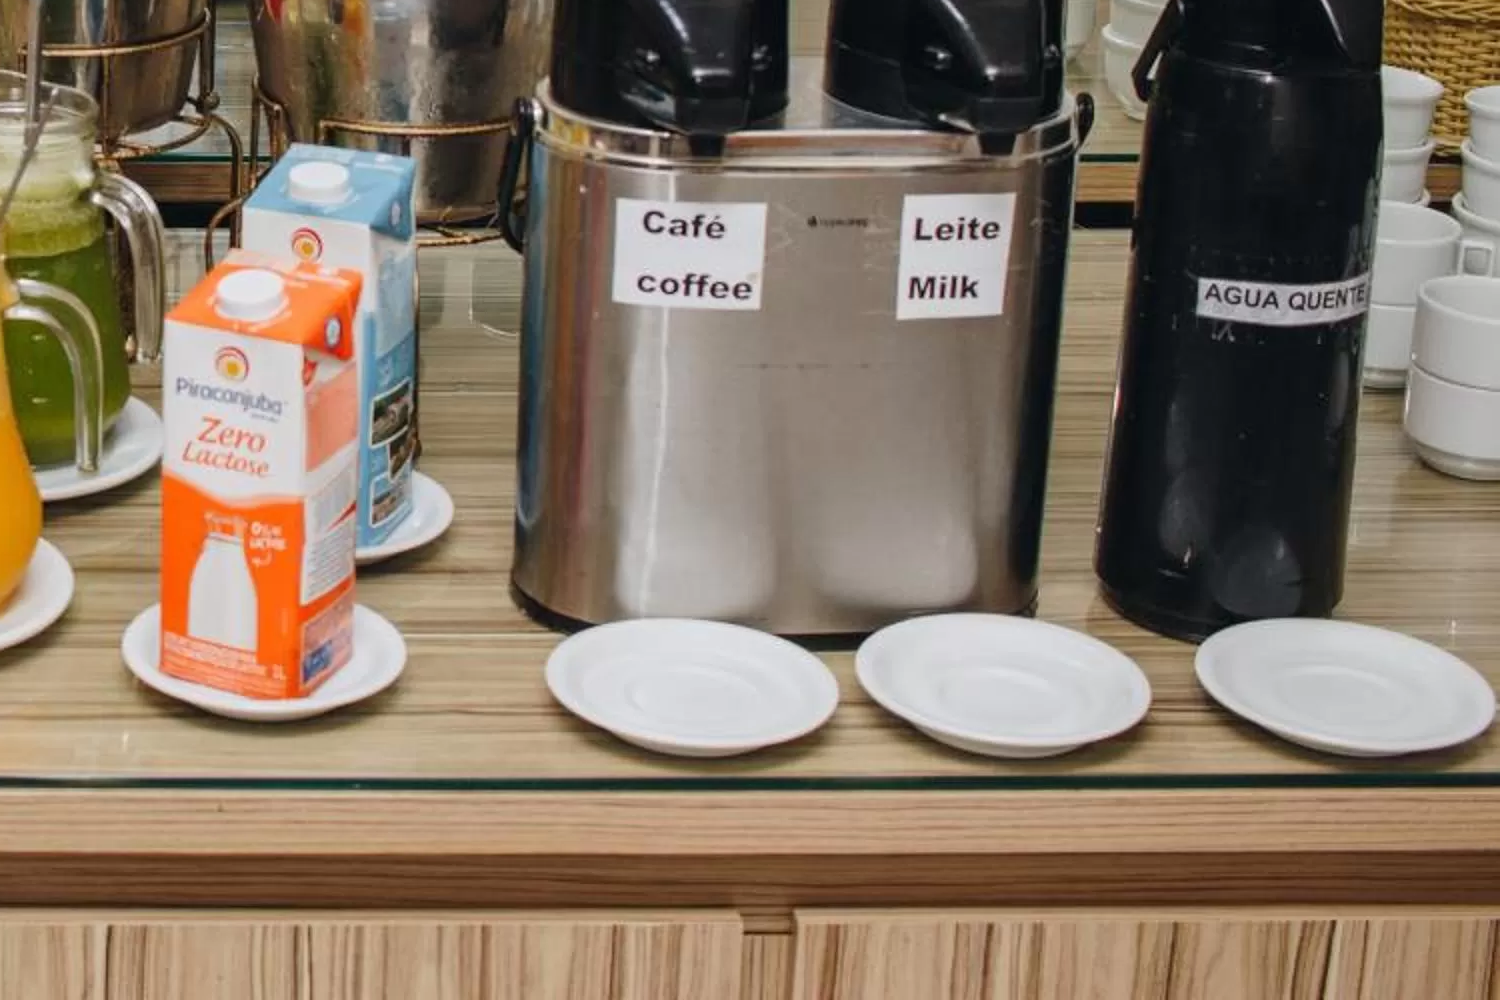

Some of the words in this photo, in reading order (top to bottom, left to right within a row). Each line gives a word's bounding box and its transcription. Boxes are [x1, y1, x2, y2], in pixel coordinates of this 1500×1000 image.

[641, 210, 726, 239] Café
[914, 217, 1000, 242] Leite
[636, 273, 753, 300] coffee
[908, 275, 979, 300] Milk
[1205, 283, 1280, 309] AGUA
[1288, 283, 1366, 311] QUENTE
[176, 377, 282, 415] Piracanjuba
[197, 416, 267, 453] Zero
[182, 440, 271, 478] Lactose
